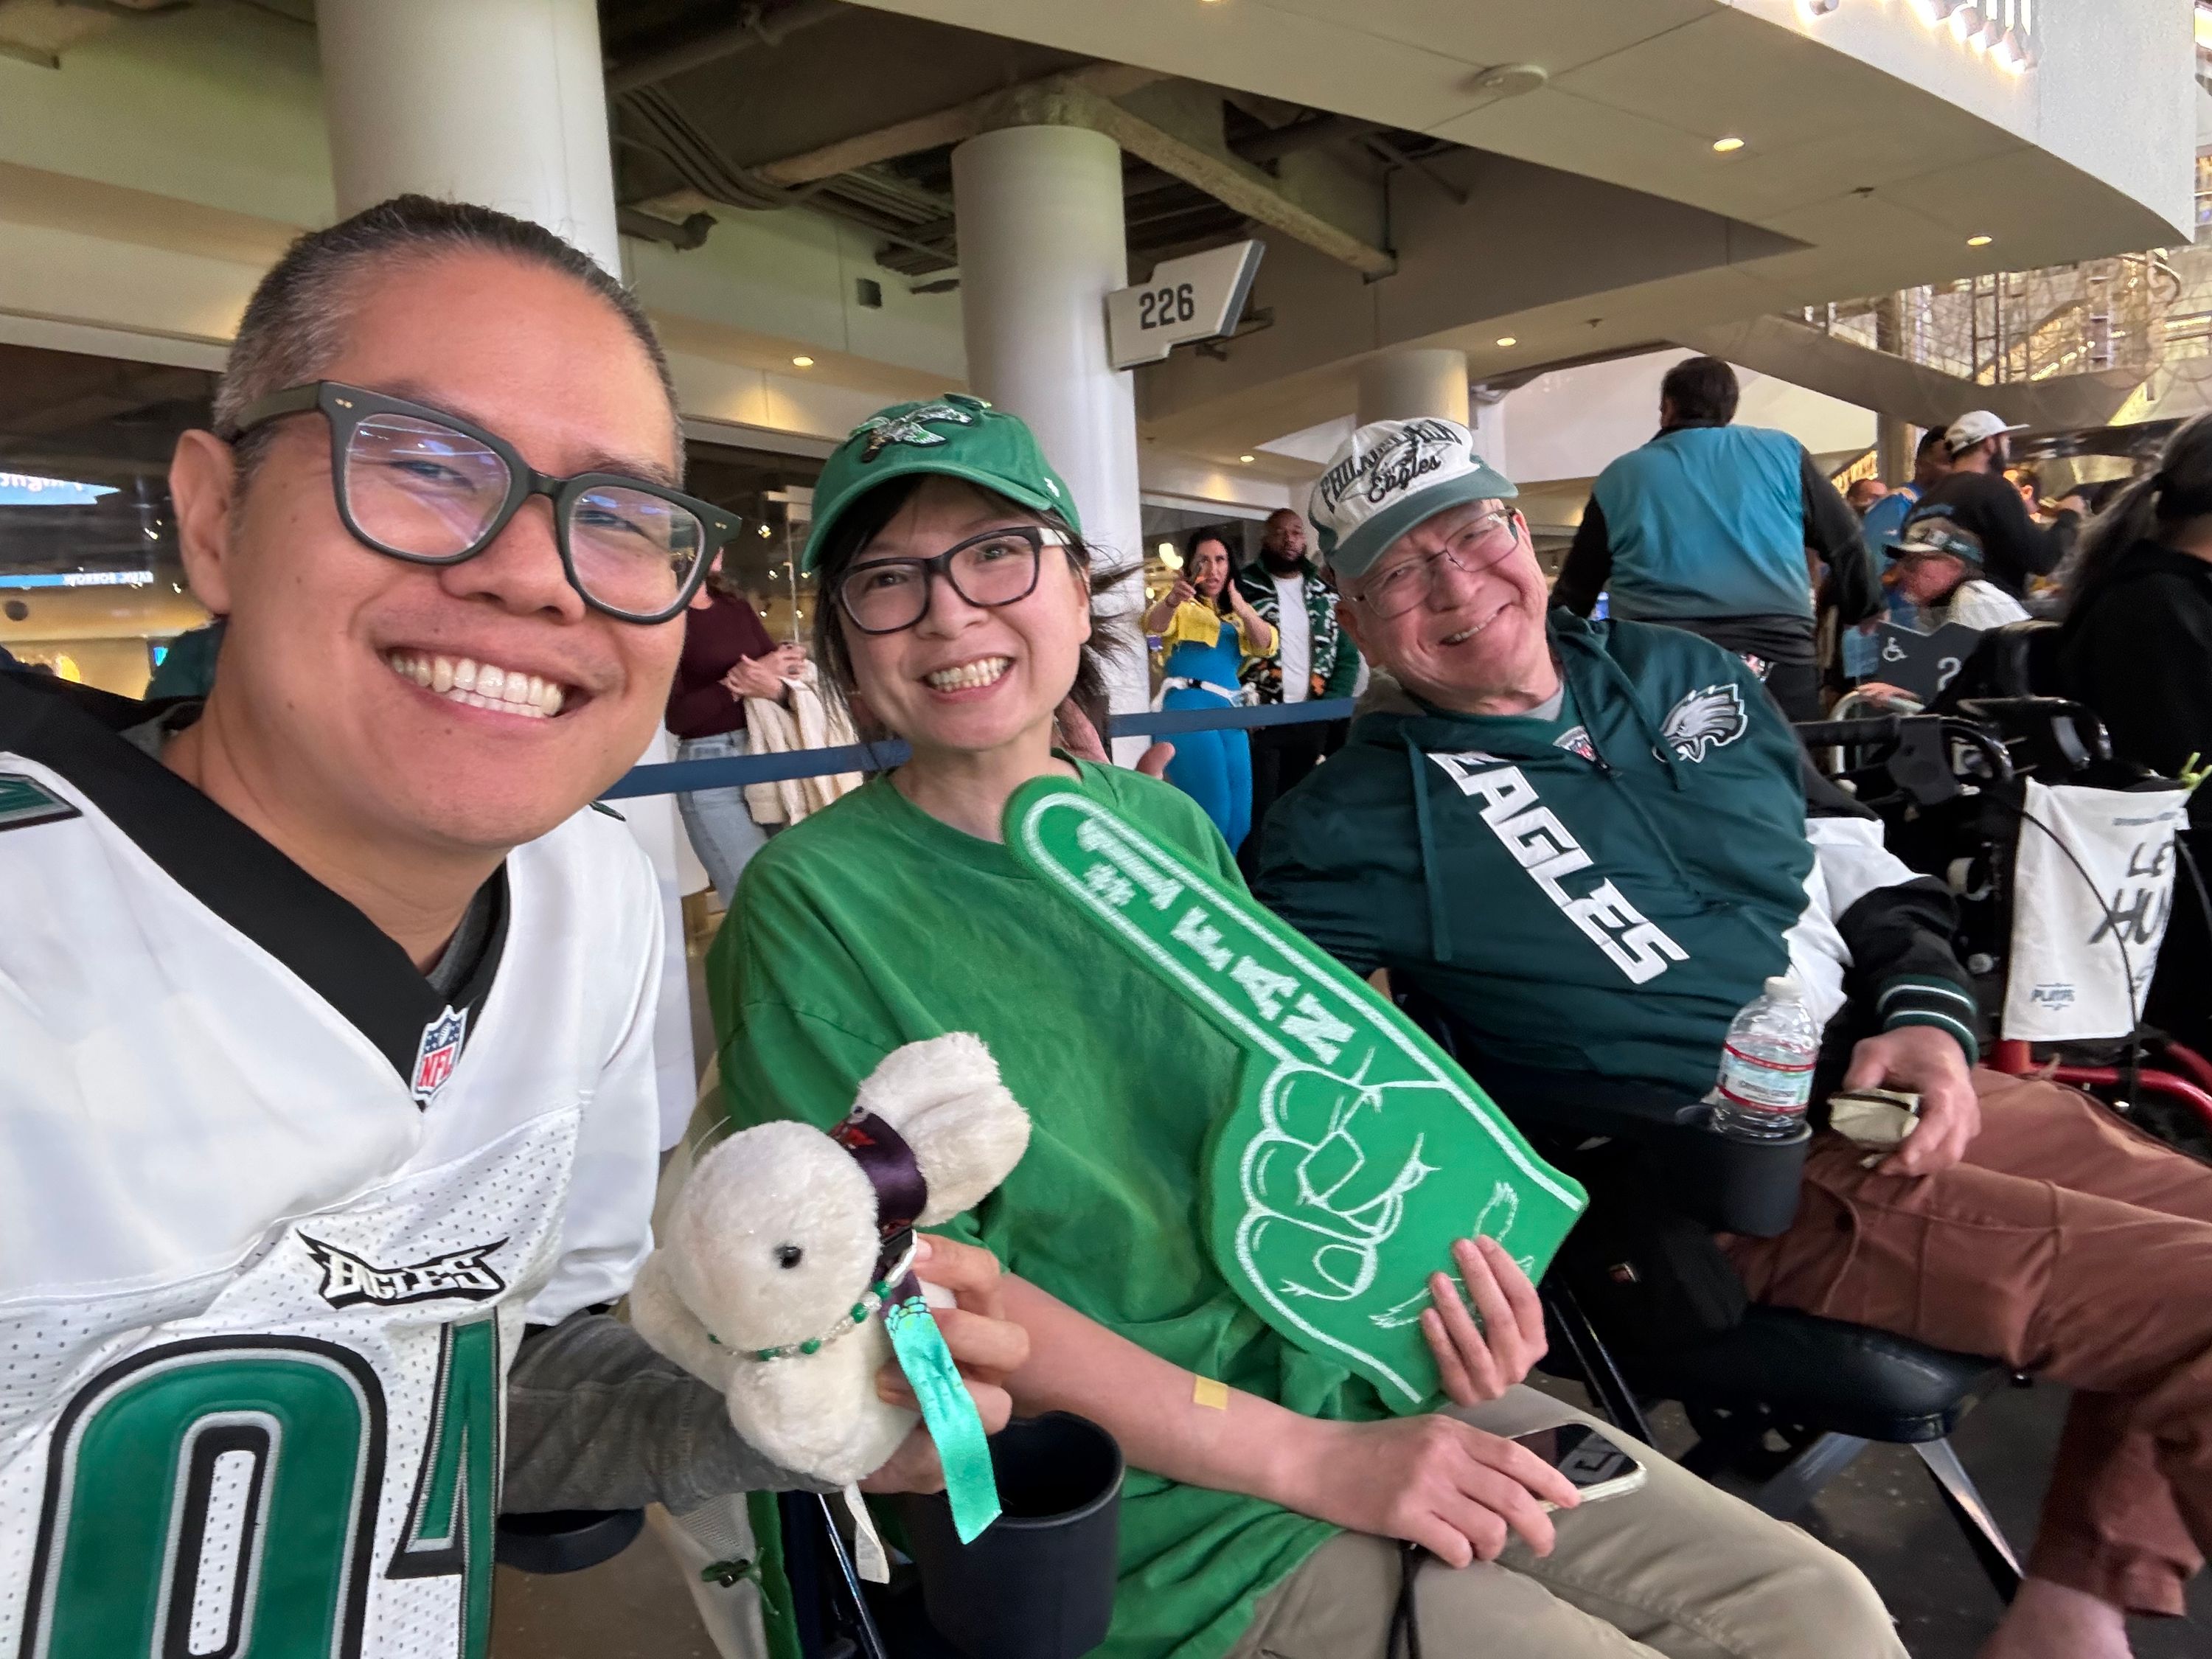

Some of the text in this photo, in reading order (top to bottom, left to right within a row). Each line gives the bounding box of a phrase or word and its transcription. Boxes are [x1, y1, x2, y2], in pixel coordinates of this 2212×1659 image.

[1138, 284, 1194, 330] 226
[1320, 420, 1463, 514] PHILADHIA
[1368, 454, 1441, 503] Eagles
[1427, 751, 1691, 985] EAGLES
[1076, 816, 1357, 1065] #1 FAN
[417, 1045, 456, 1088] NFL
